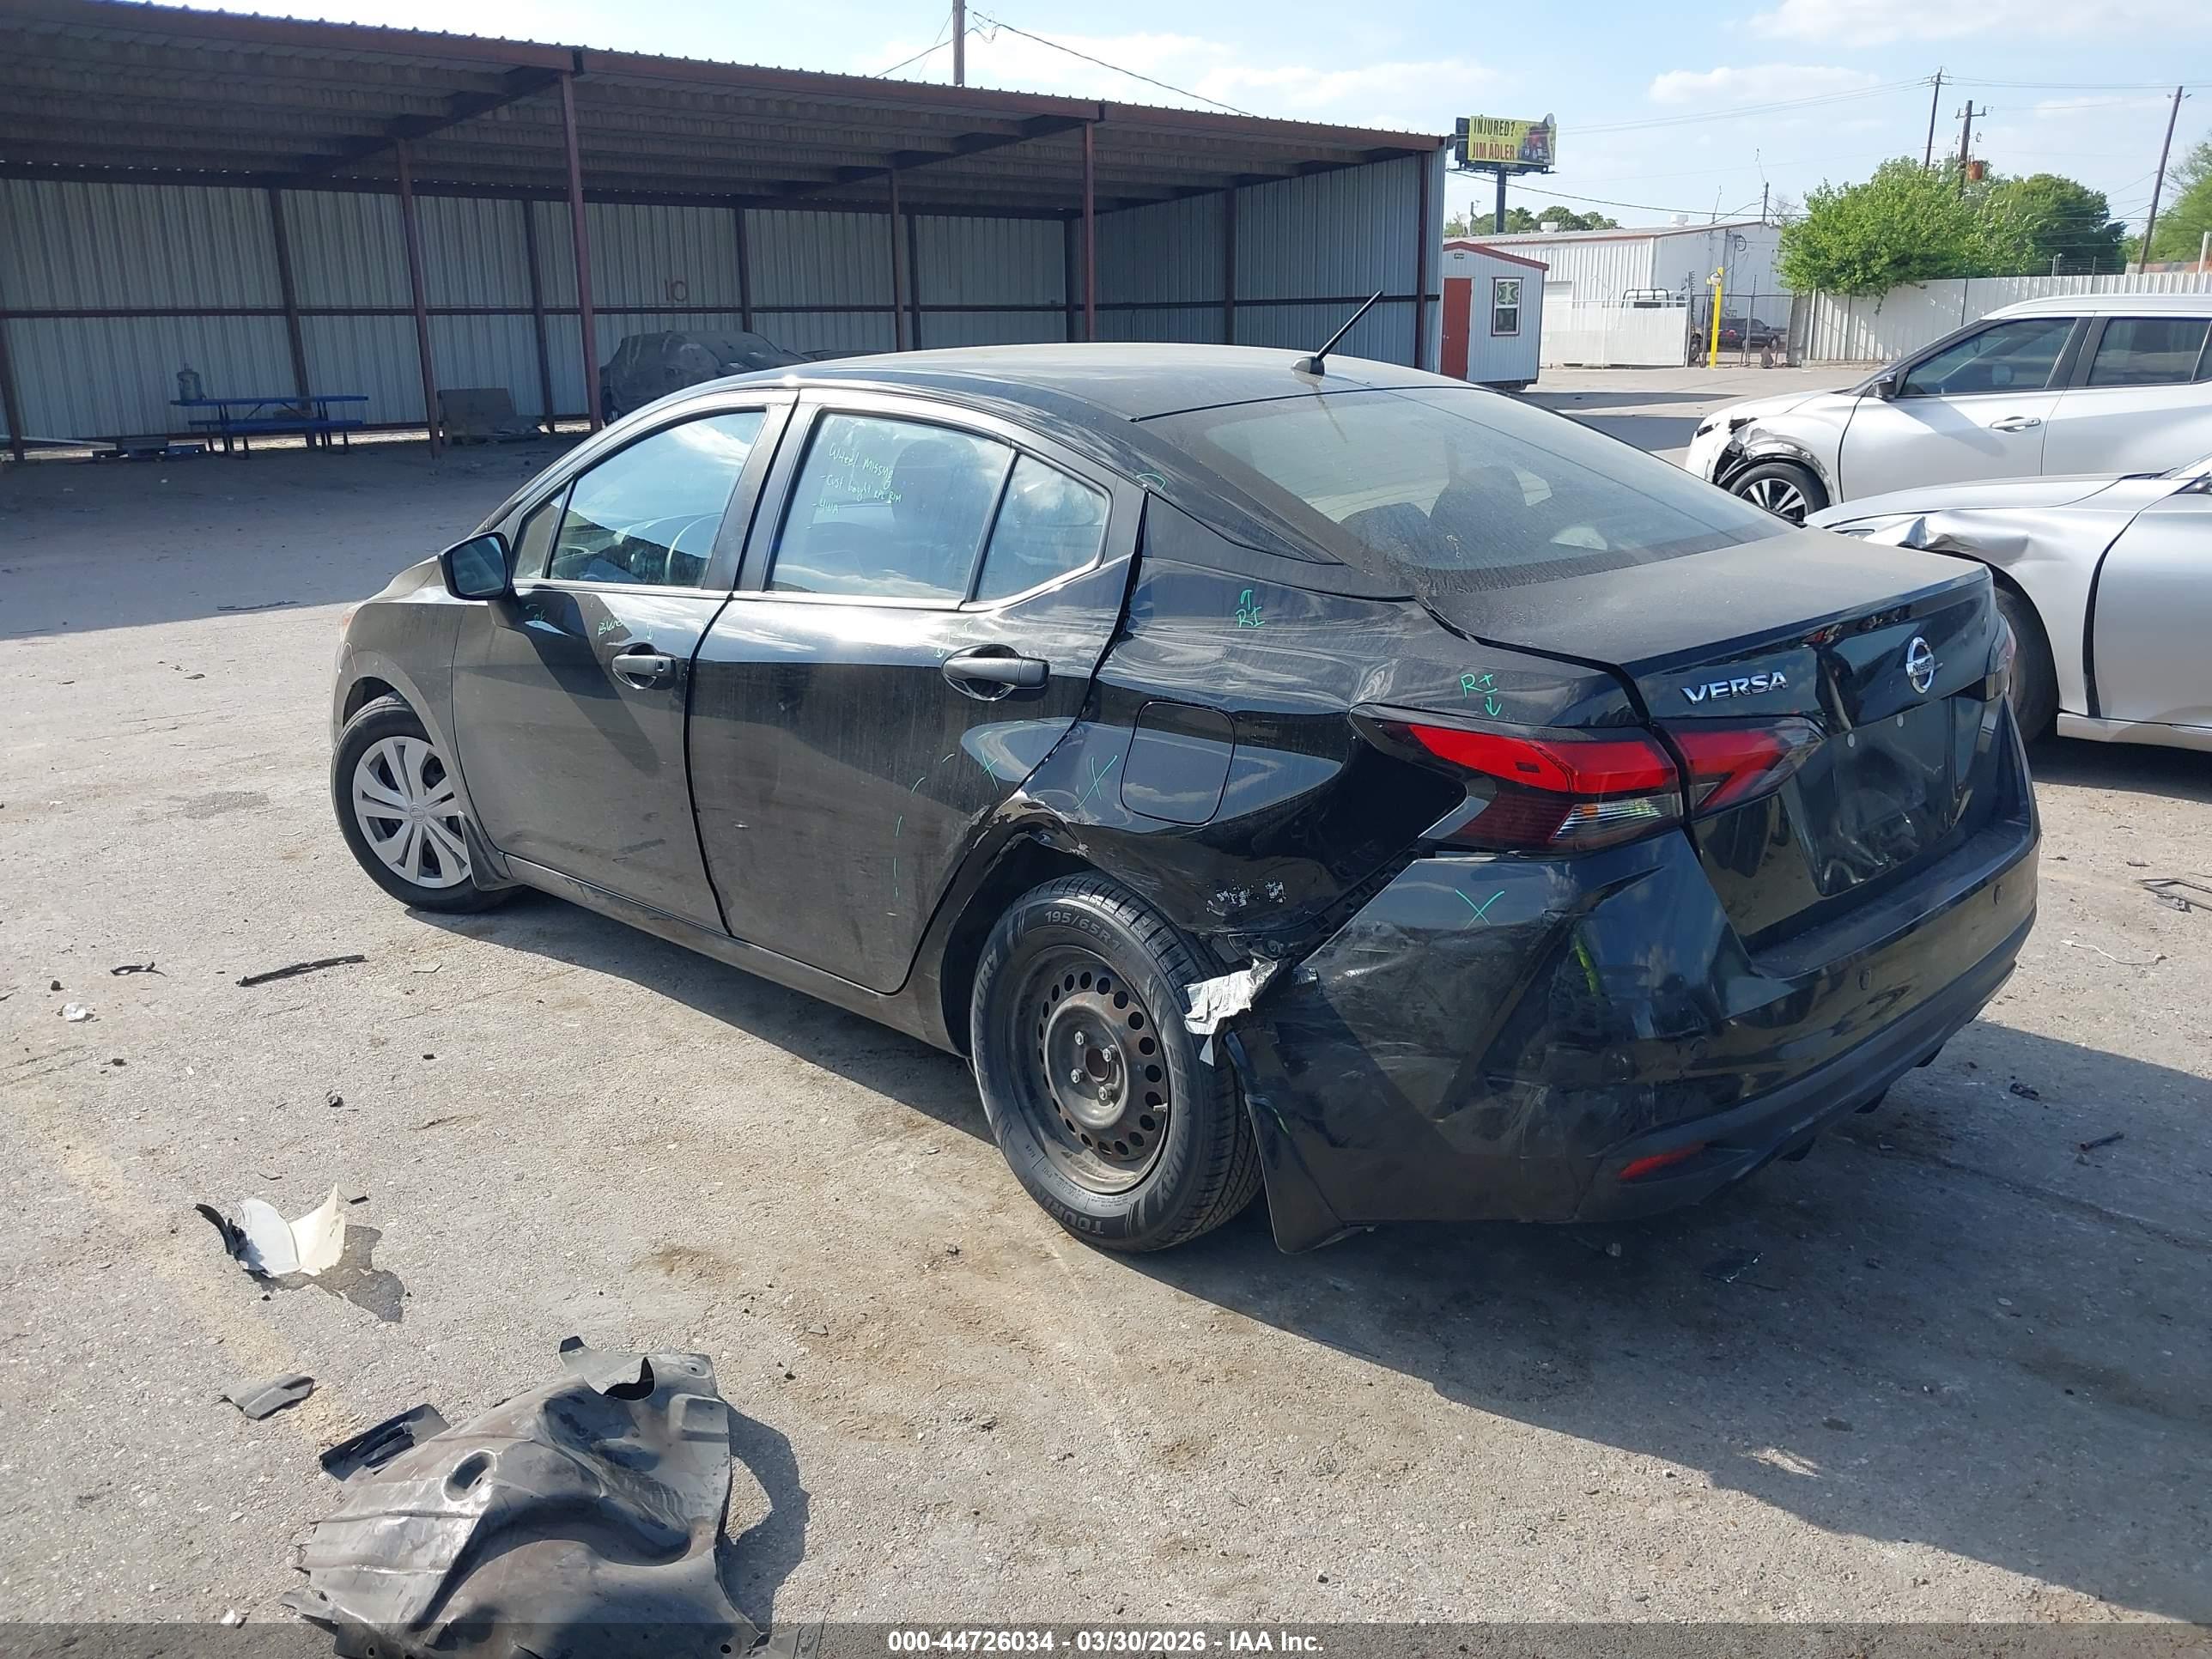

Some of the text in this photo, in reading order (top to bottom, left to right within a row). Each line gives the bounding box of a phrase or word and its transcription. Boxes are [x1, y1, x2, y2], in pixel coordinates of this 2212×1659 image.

[1474, 118, 1516, 137] INJURED?
[1472, 142, 1515, 161] JIM ADLER
[1680, 672, 1789, 706] VERSA
